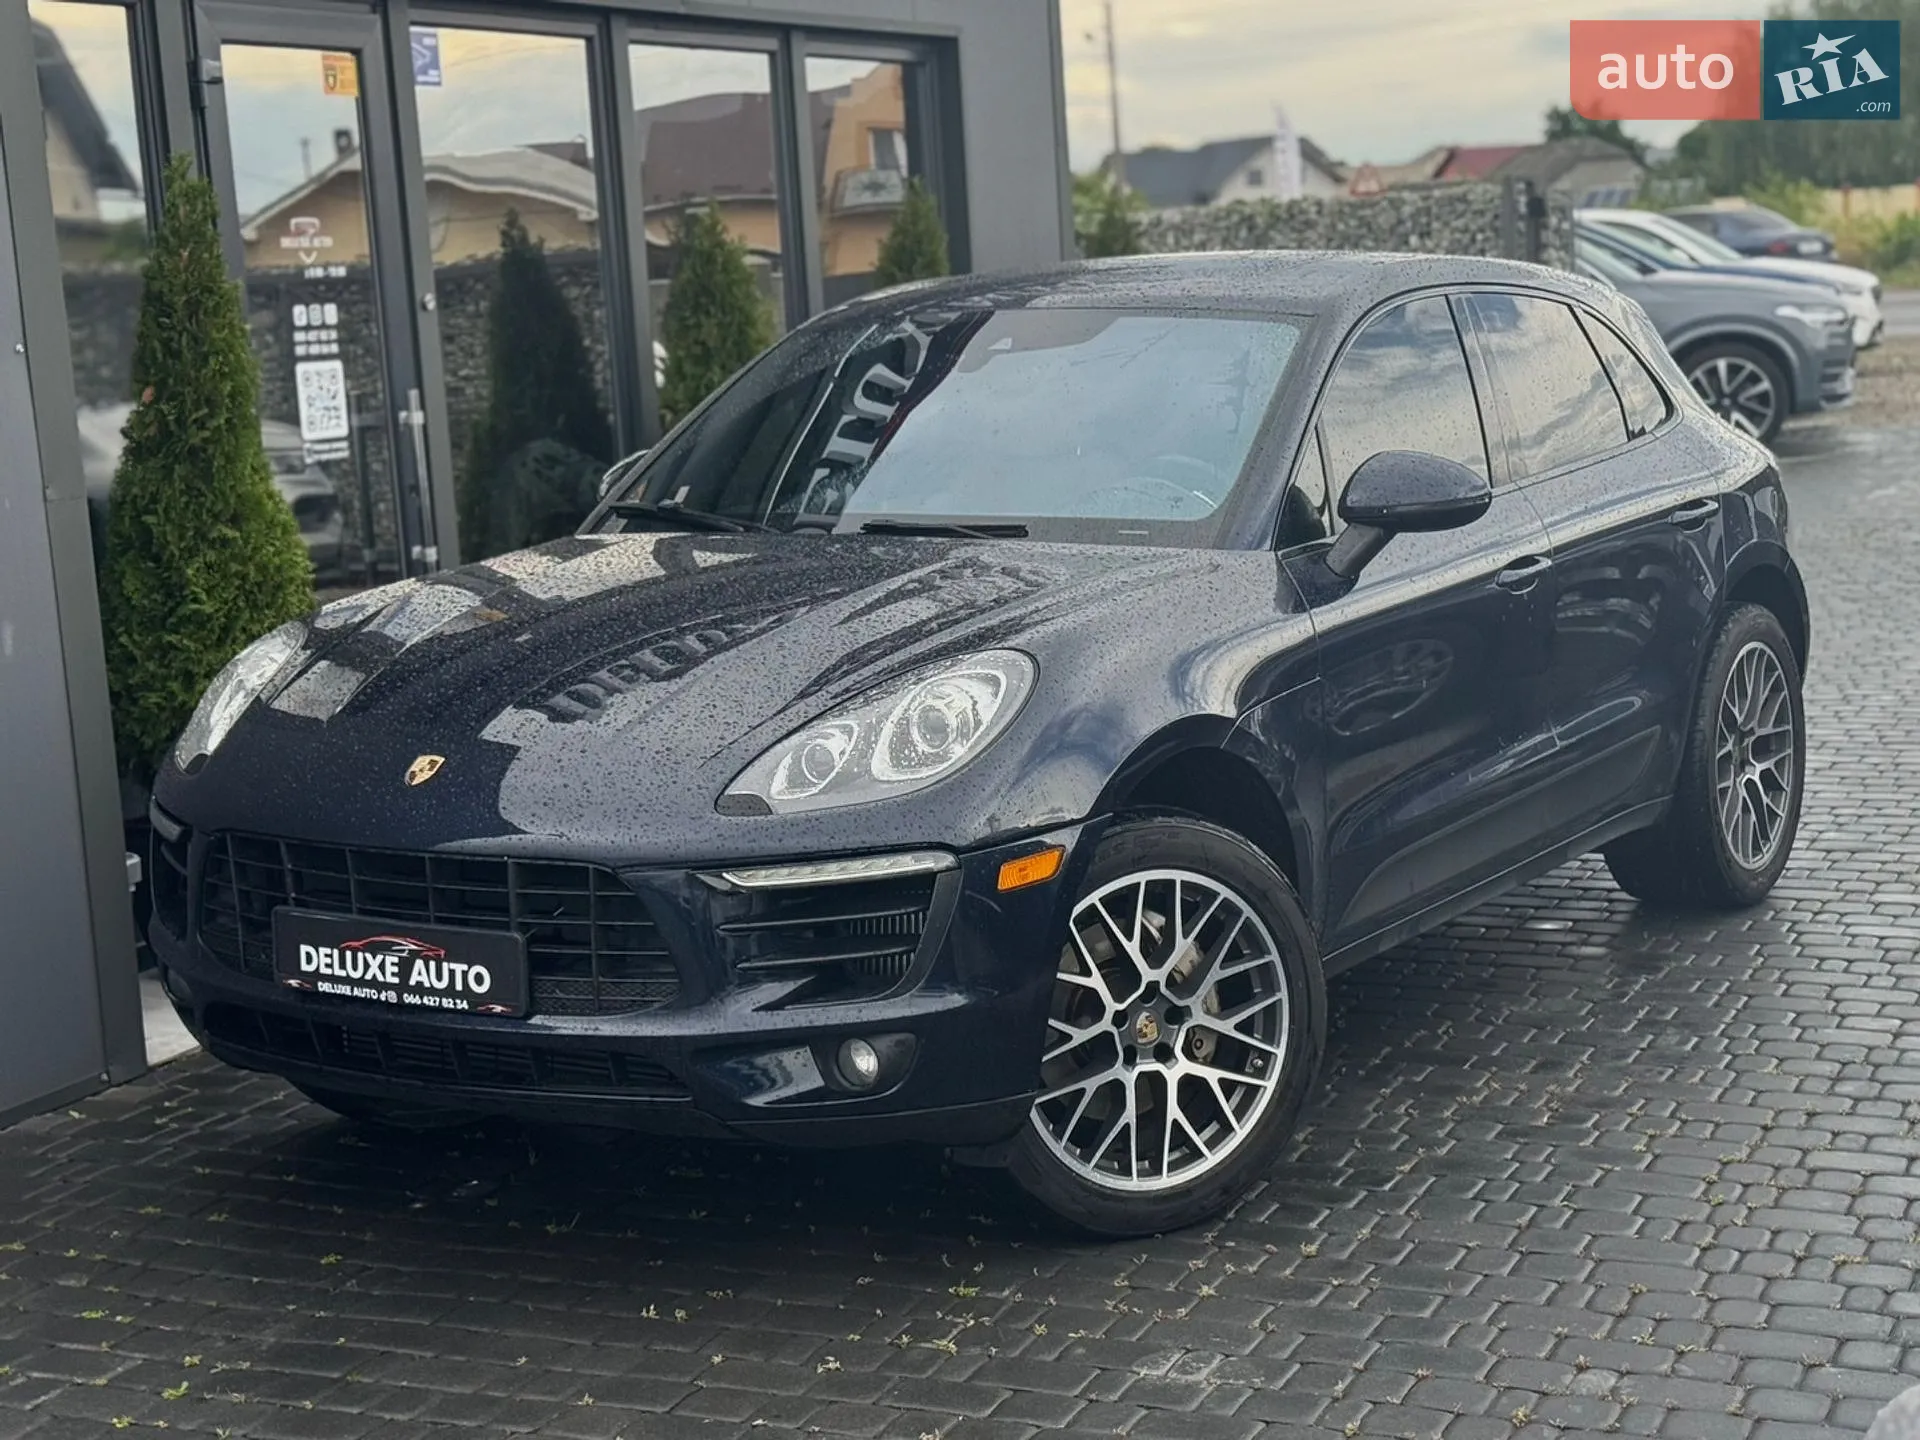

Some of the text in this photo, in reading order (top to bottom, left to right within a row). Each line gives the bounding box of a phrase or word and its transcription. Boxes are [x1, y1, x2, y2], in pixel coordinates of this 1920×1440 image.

[299, 944, 491, 994] DELUXE AUTO
[317, 981, 352, 995] DELUXE
[353, 986, 379, 1000] AUTO
[403, 993, 422, 1005] 066
